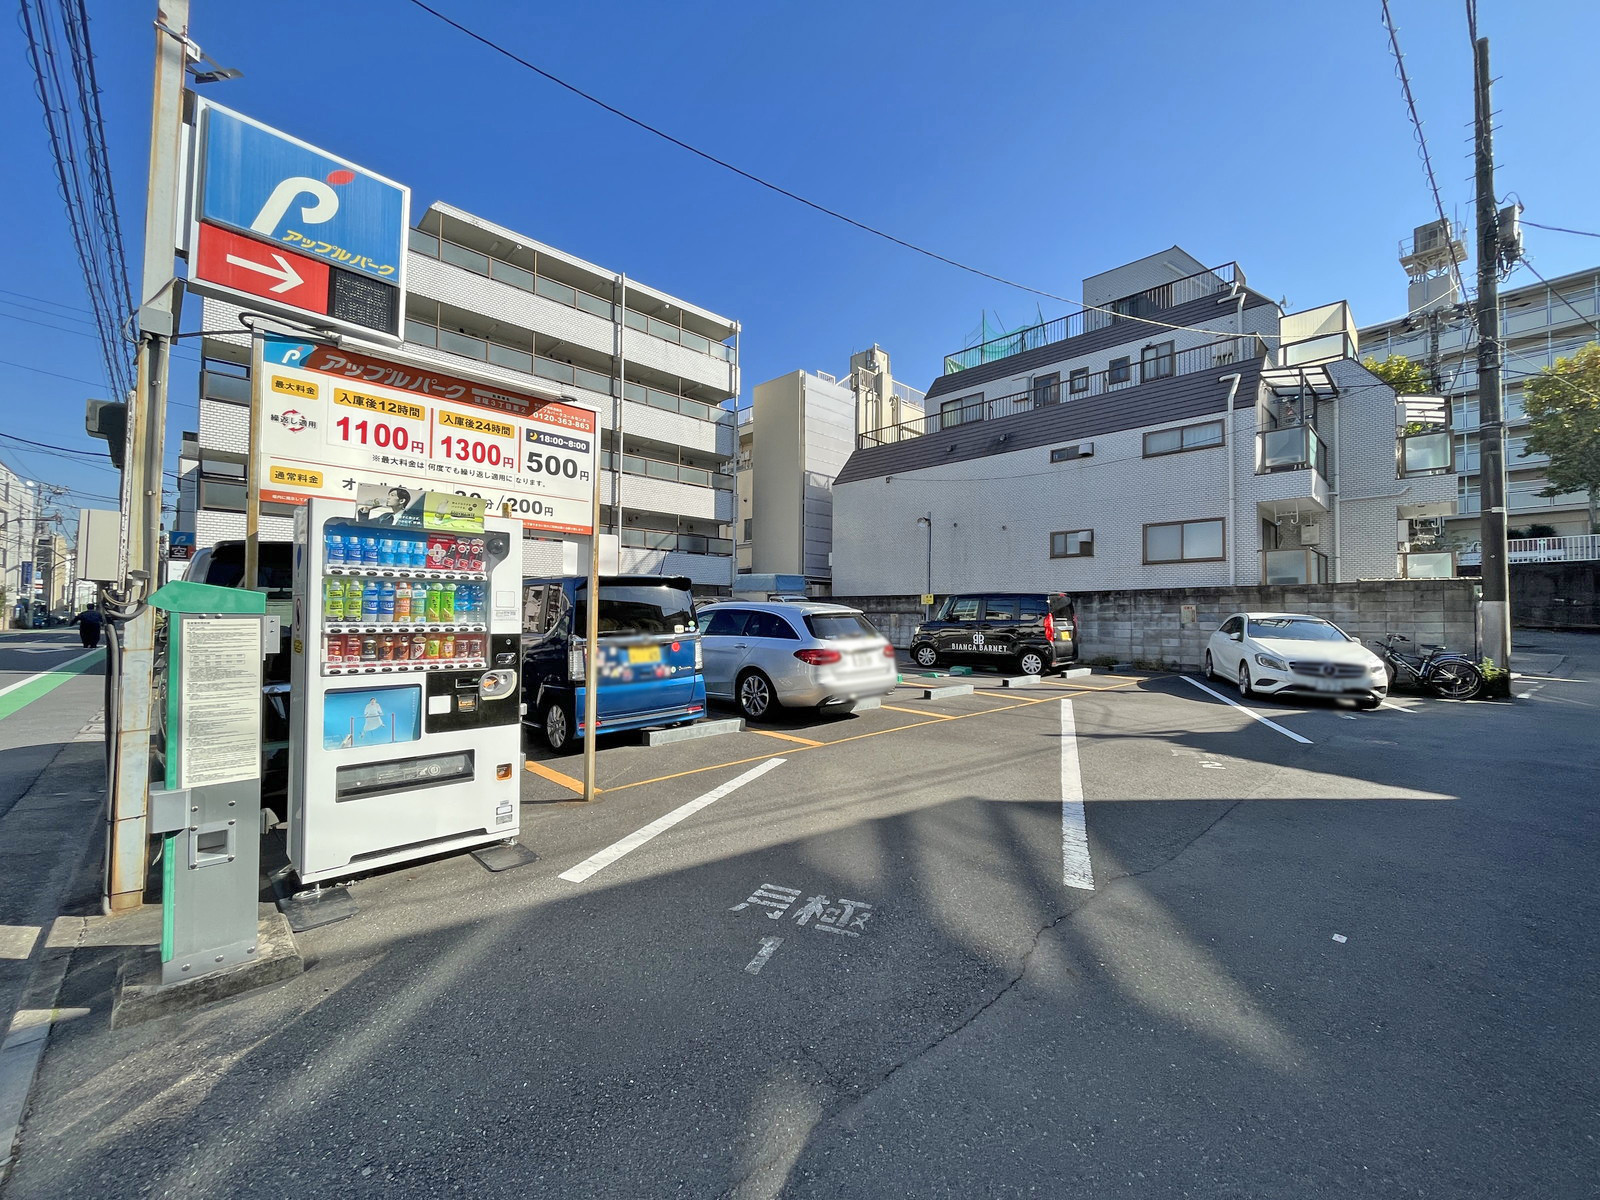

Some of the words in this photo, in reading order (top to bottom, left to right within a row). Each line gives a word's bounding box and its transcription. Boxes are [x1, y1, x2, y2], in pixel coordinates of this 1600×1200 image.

[282, 229, 395, 275] アップルパーク
[275, 380, 316, 396] 最大料金
[319, 354, 466, 399] アップルパーク
[340, 392, 421, 418] 入庫後12時間
[443, 414, 511, 436] 入庫後24時間
[533, 411, 590, 430] 0120-363-863
[336, 416, 425, 454] 1100円
[440, 435, 515, 469] 1300円
[274, 470, 319, 484] 通常料金
[526, 451, 590, 482] 500円
[171, 546, 187, 558] 空
[951, 642, 977, 651] BIANCA
[979, 644, 1008, 653] BARNET
[729, 883, 873, 938] 月極
[744, 935, 785, 976] 1
